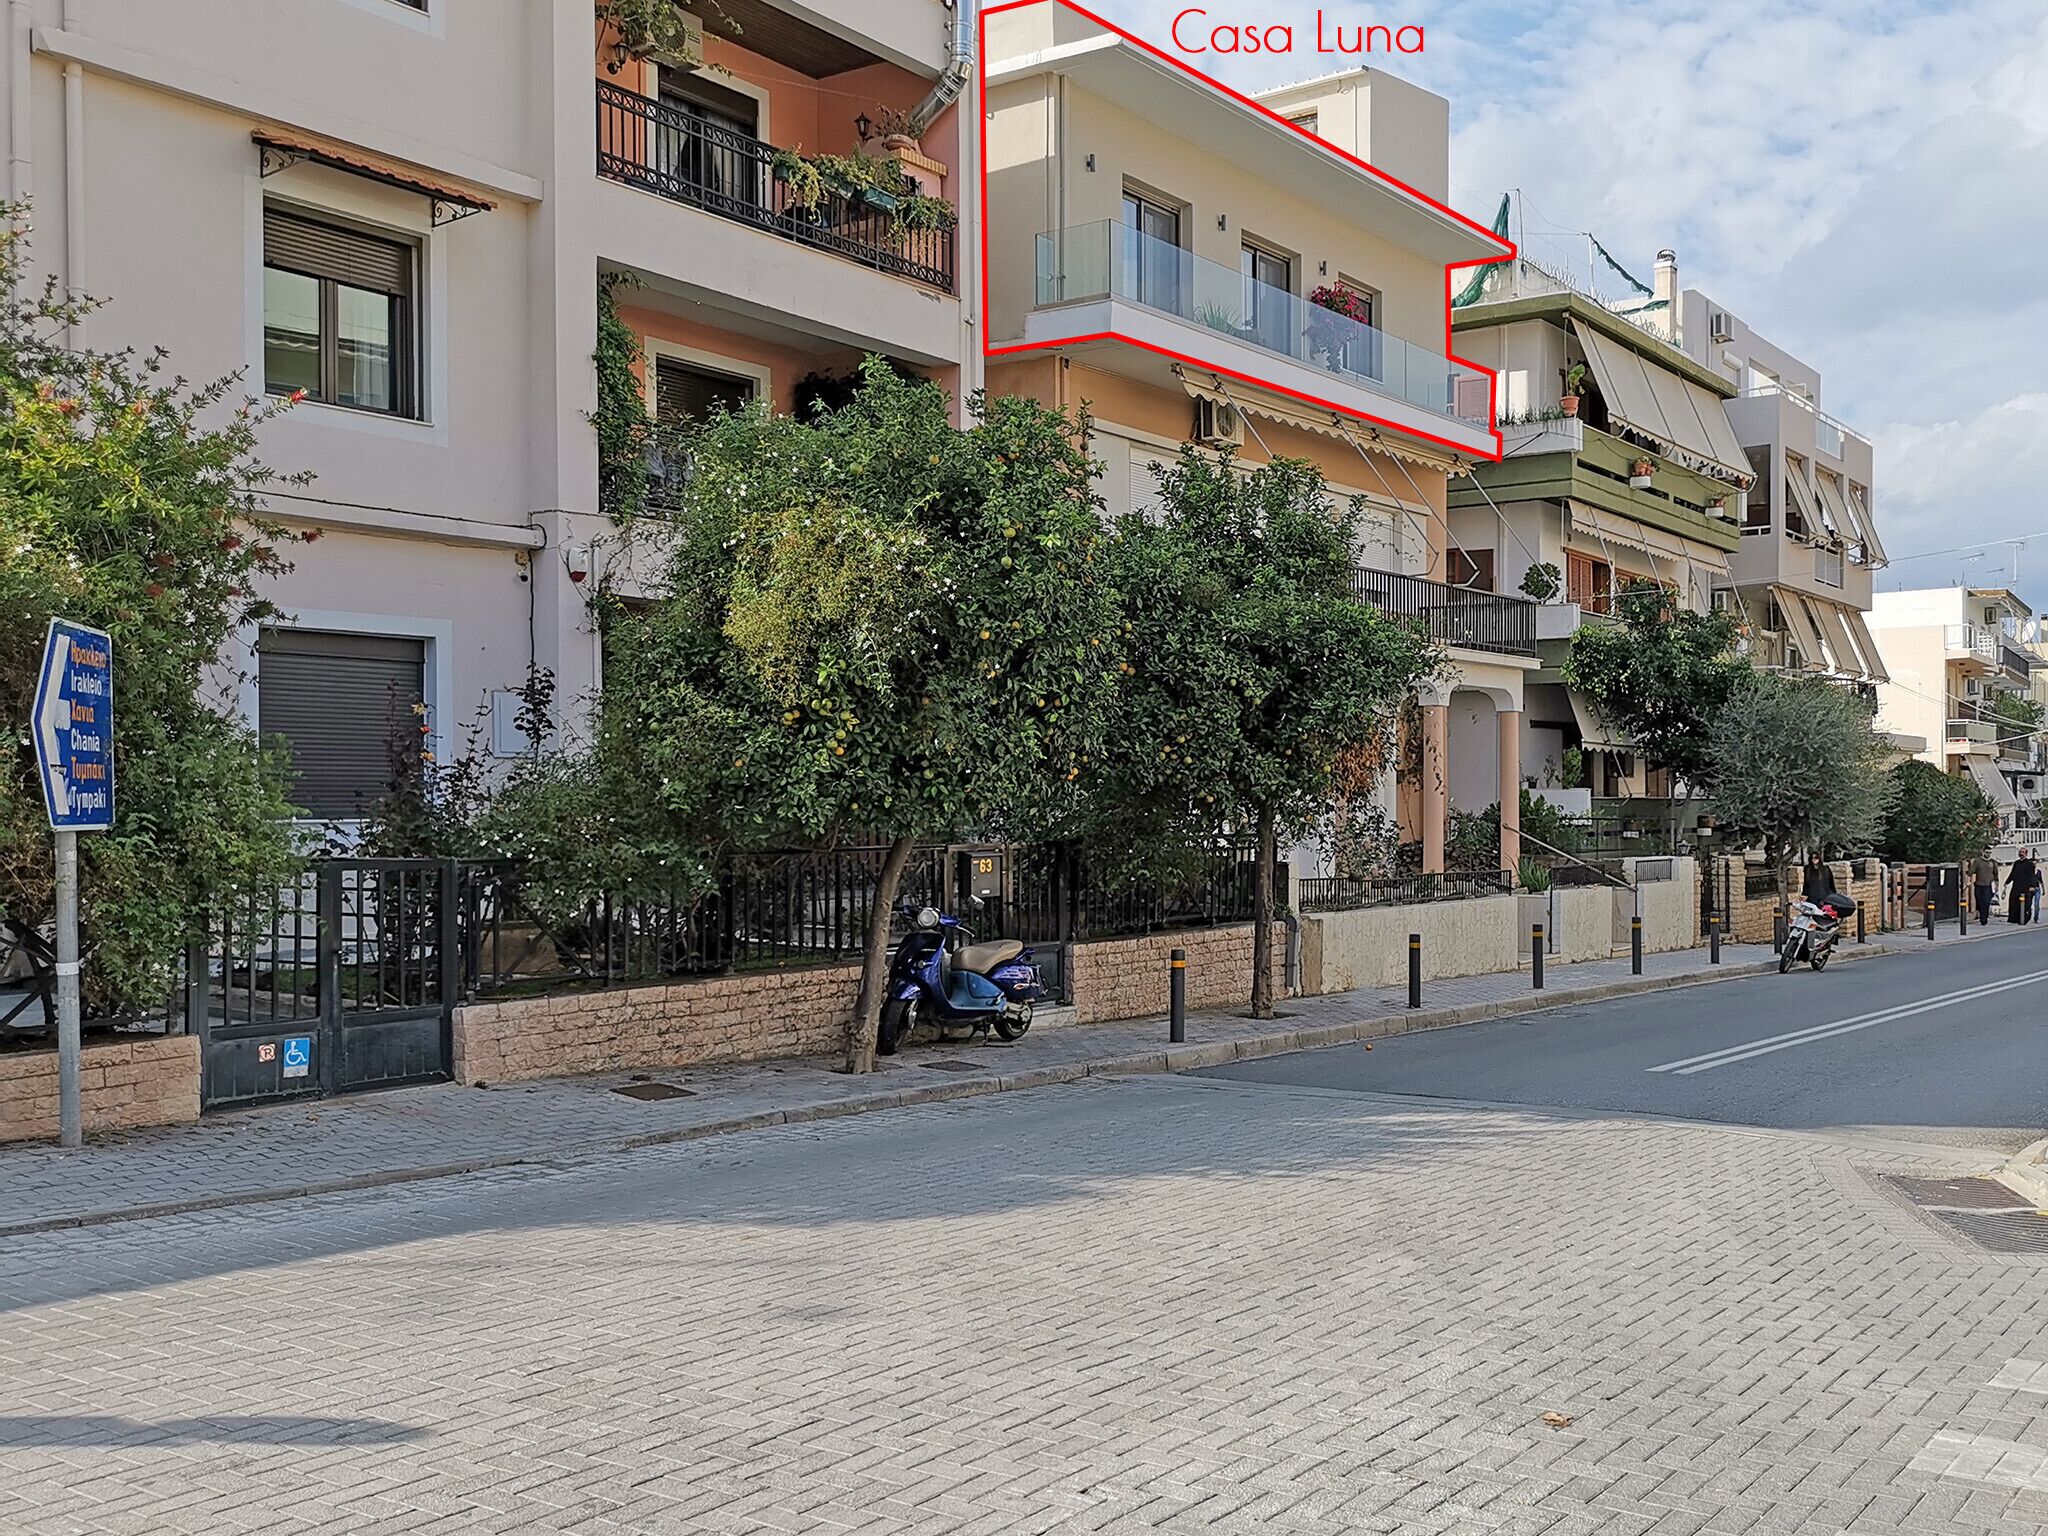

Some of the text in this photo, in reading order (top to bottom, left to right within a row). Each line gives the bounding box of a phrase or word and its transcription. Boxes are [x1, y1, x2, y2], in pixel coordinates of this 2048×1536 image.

[71, 669, 103, 696] Irakleio
[71, 727, 101, 752] Chania
[71, 786, 106, 816] Tympaki
[979, 858, 993, 873] 63
